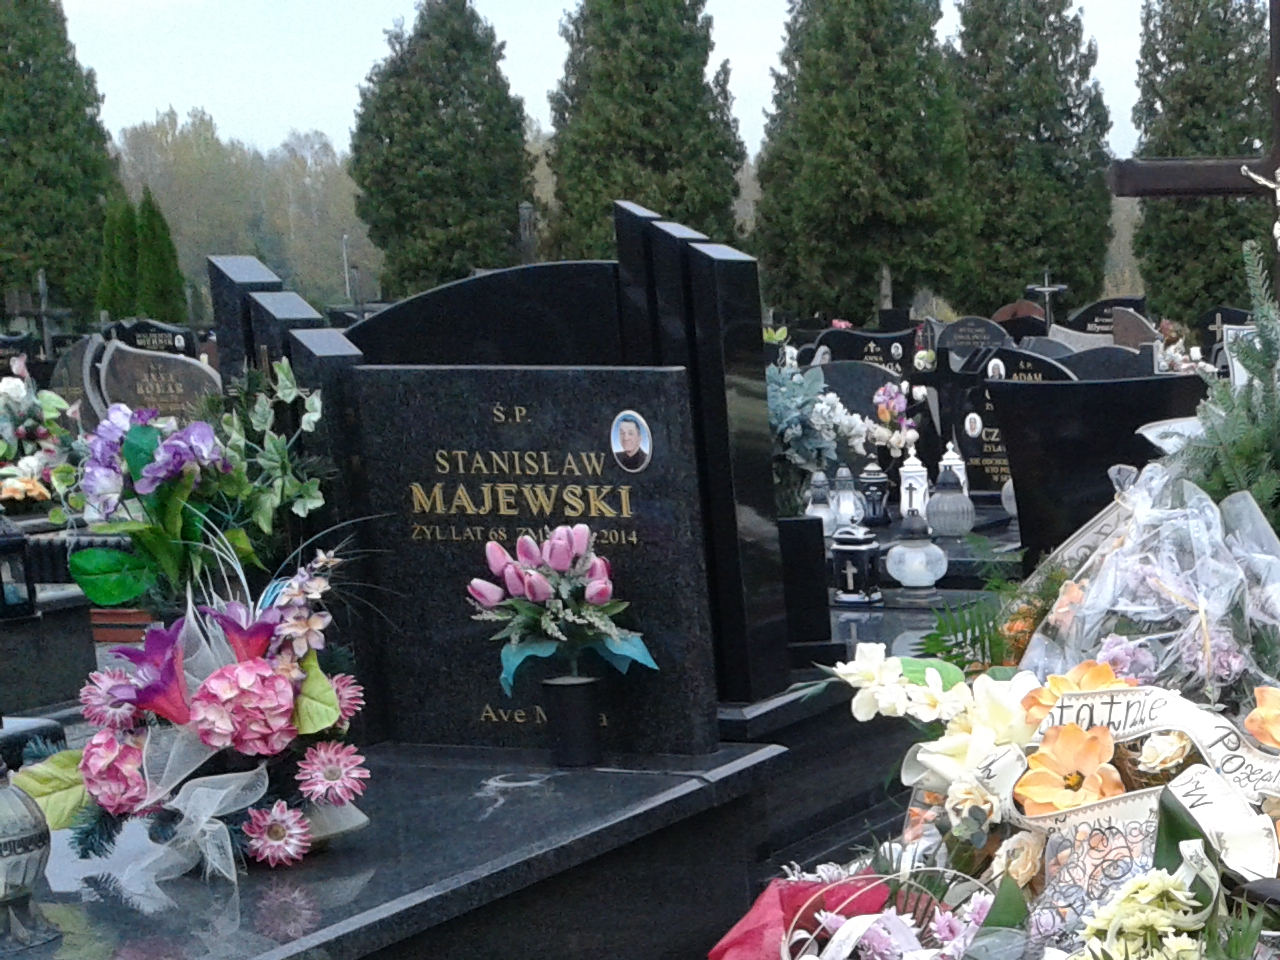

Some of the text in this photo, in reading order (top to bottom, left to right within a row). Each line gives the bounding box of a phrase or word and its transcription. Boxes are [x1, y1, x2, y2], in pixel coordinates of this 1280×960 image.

[493, 402, 532, 422] Ś.P.
[434, 449, 606, 477] STANISŁAW
[409, 482, 635, 518] MAJEWSKI
[451, 525, 485, 541] LAT
[488, 528, 508, 541] 68
[479, 703, 527, 723] Ave
